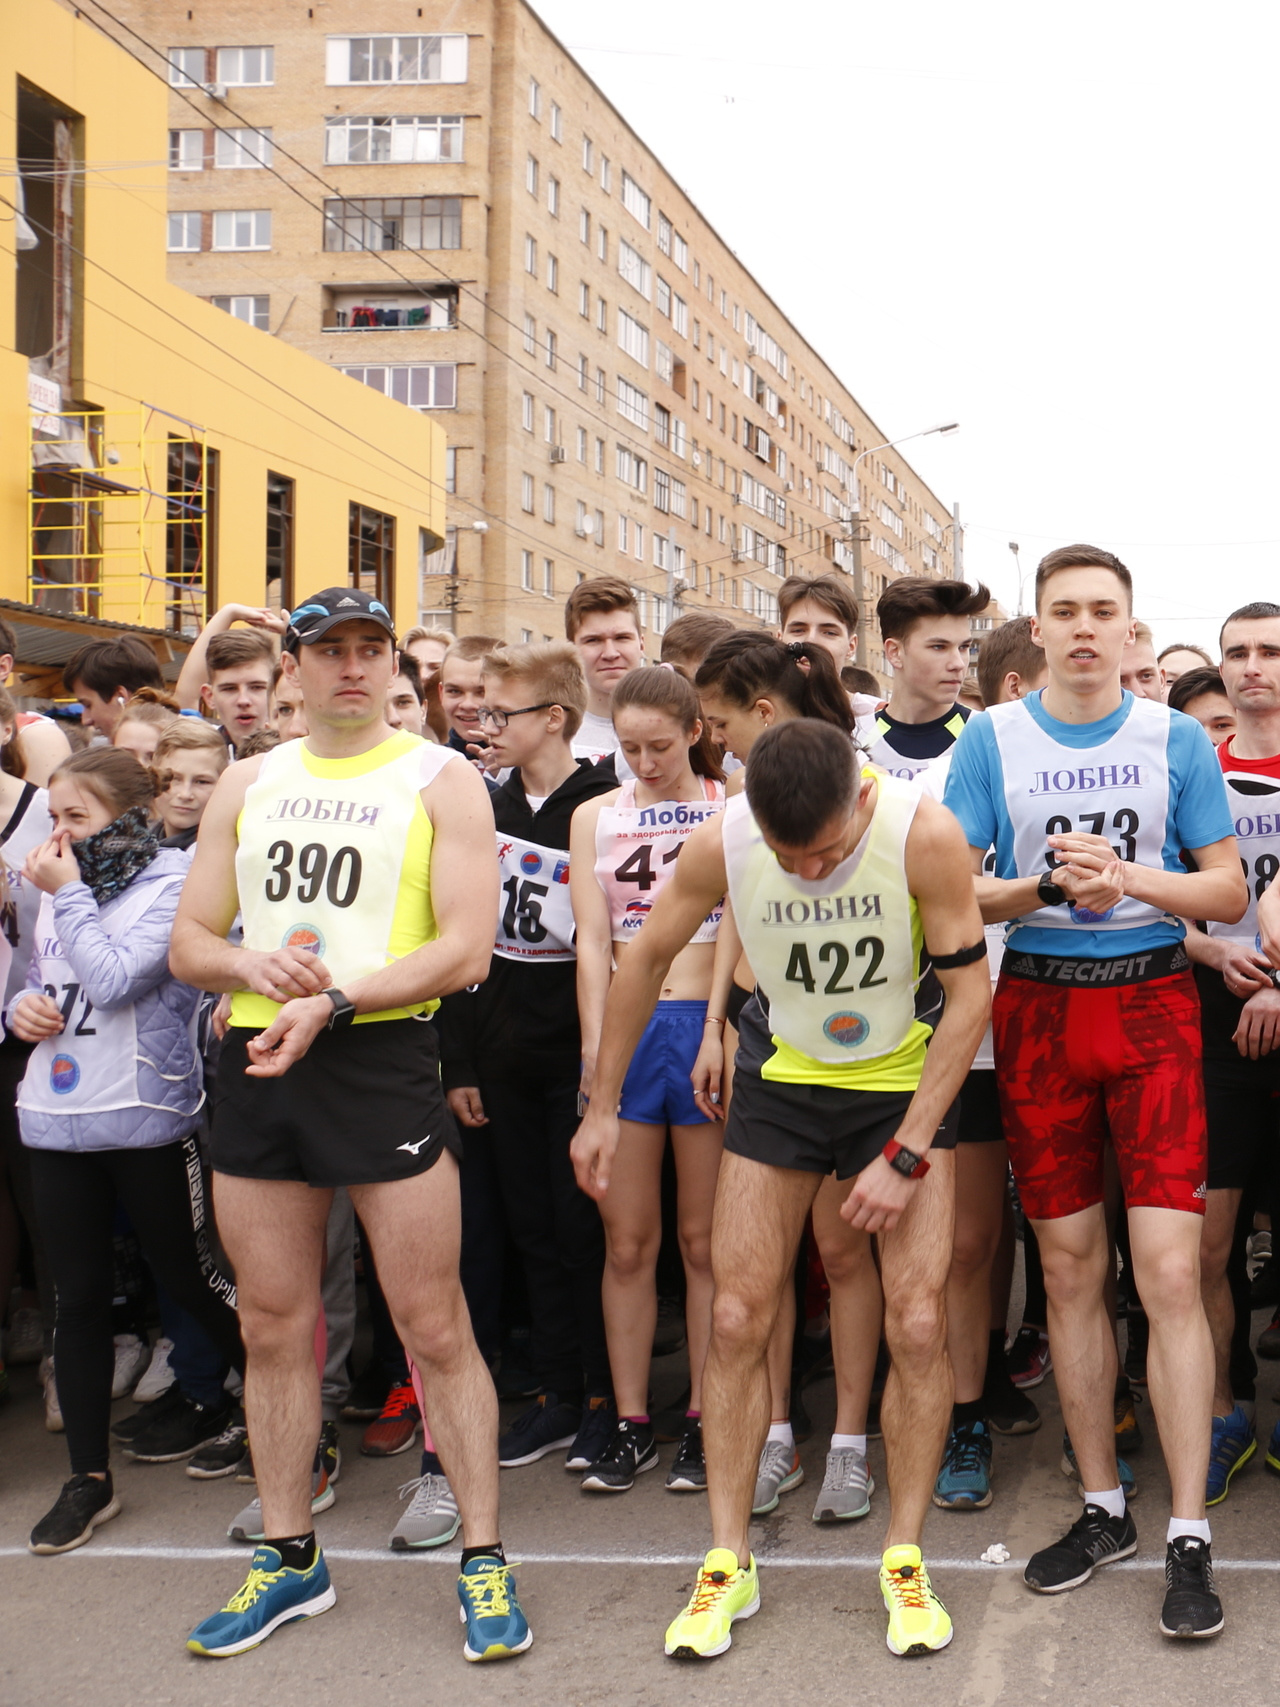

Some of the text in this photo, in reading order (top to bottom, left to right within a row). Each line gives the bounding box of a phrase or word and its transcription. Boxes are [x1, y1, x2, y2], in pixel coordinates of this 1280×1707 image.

[1029, 764, 1142, 793] ЛОБНЯ
[266, 797, 381, 826] ЛОБНЯ
[265, 840, 362, 909] 390
[503, 875, 549, 943] 15
[762, 893, 883, 923] ЛОБНЯ
[785, 936, 888, 995] 422
[1011, 964, 1038, 977] adidas
[1044, 955, 1152, 982] TECHFIT
[44, 983, 97, 1036] 72
[187, 1158, 207, 1232] NEVER
[196, 1228, 216, 1276] GIVE
